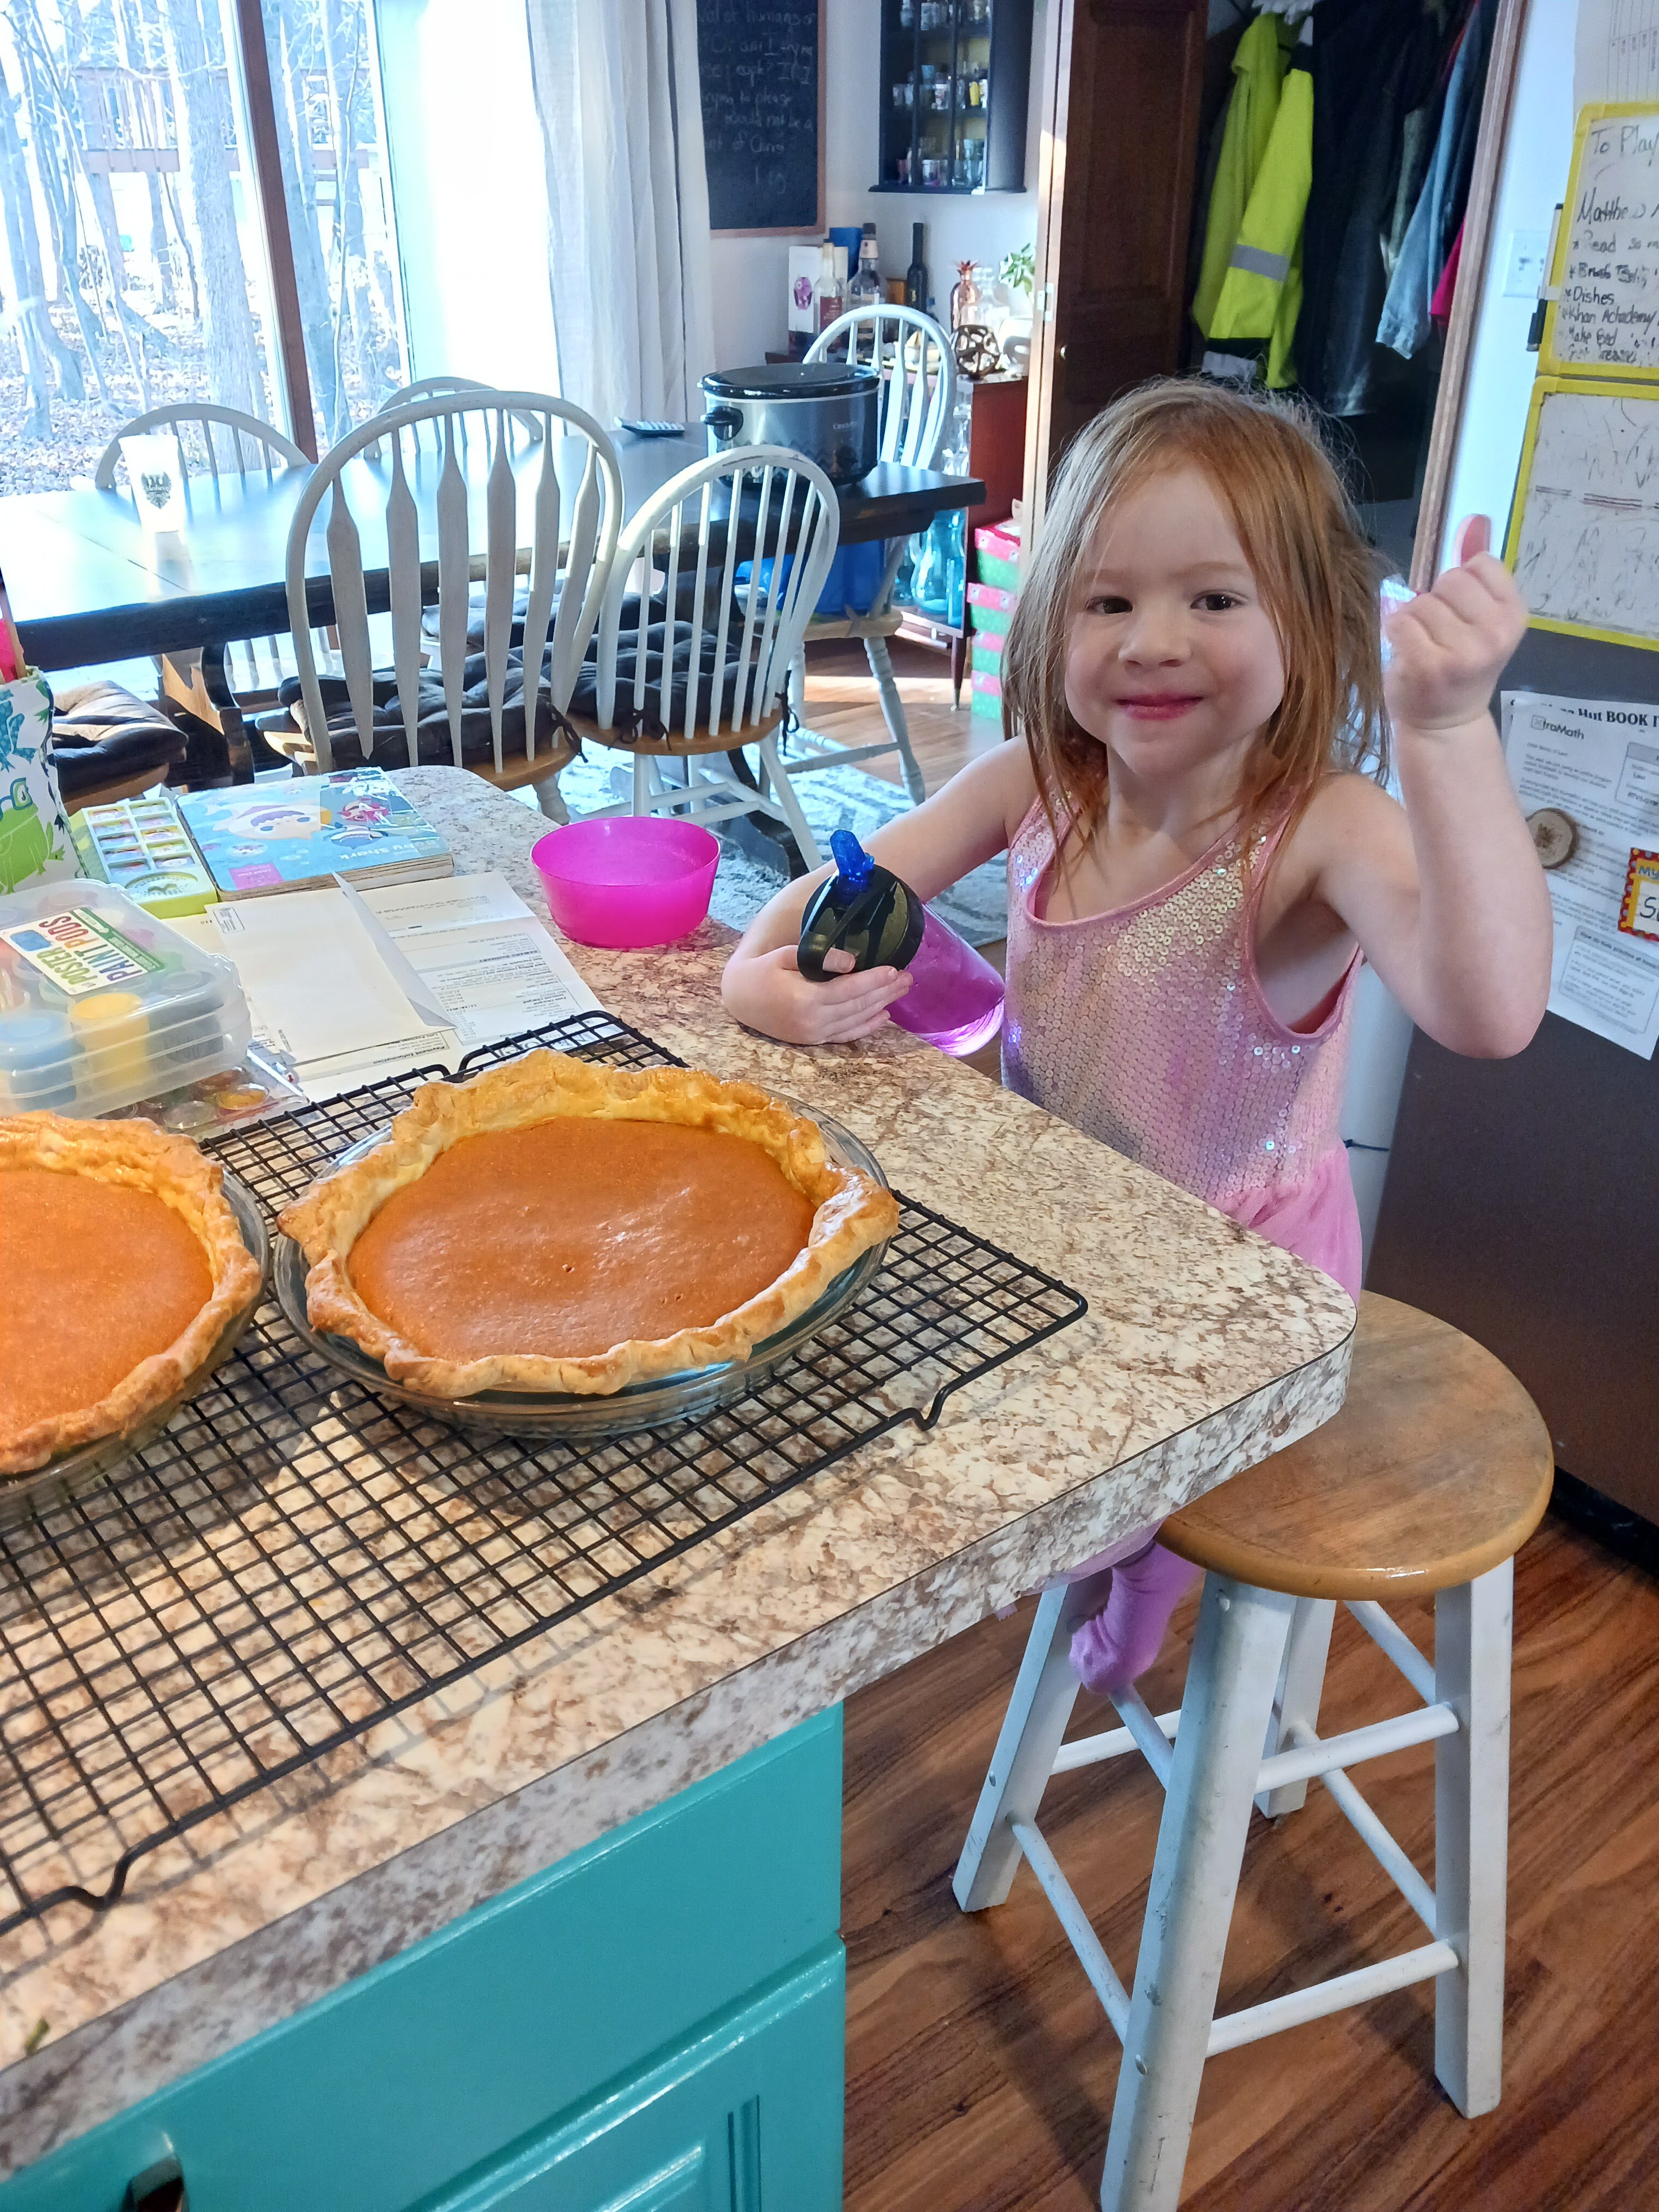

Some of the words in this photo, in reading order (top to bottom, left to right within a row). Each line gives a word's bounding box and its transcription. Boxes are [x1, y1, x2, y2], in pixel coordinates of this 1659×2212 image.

[1591, 126, 1615, 154] To
[1573, 286, 1615, 305] Dishes
[1606, 710, 1648, 726] BOOK
[1653, 715, 1659, 727] I
[1638, 865, 1659, 880] My
[38, 915, 100, 949] PODS
[36, 947, 98, 985] POSTER
[76, 944, 143, 982] PAINT
[372, 1052, 414, 1064] Information
[415, 1046, 445, 1055] Payment
